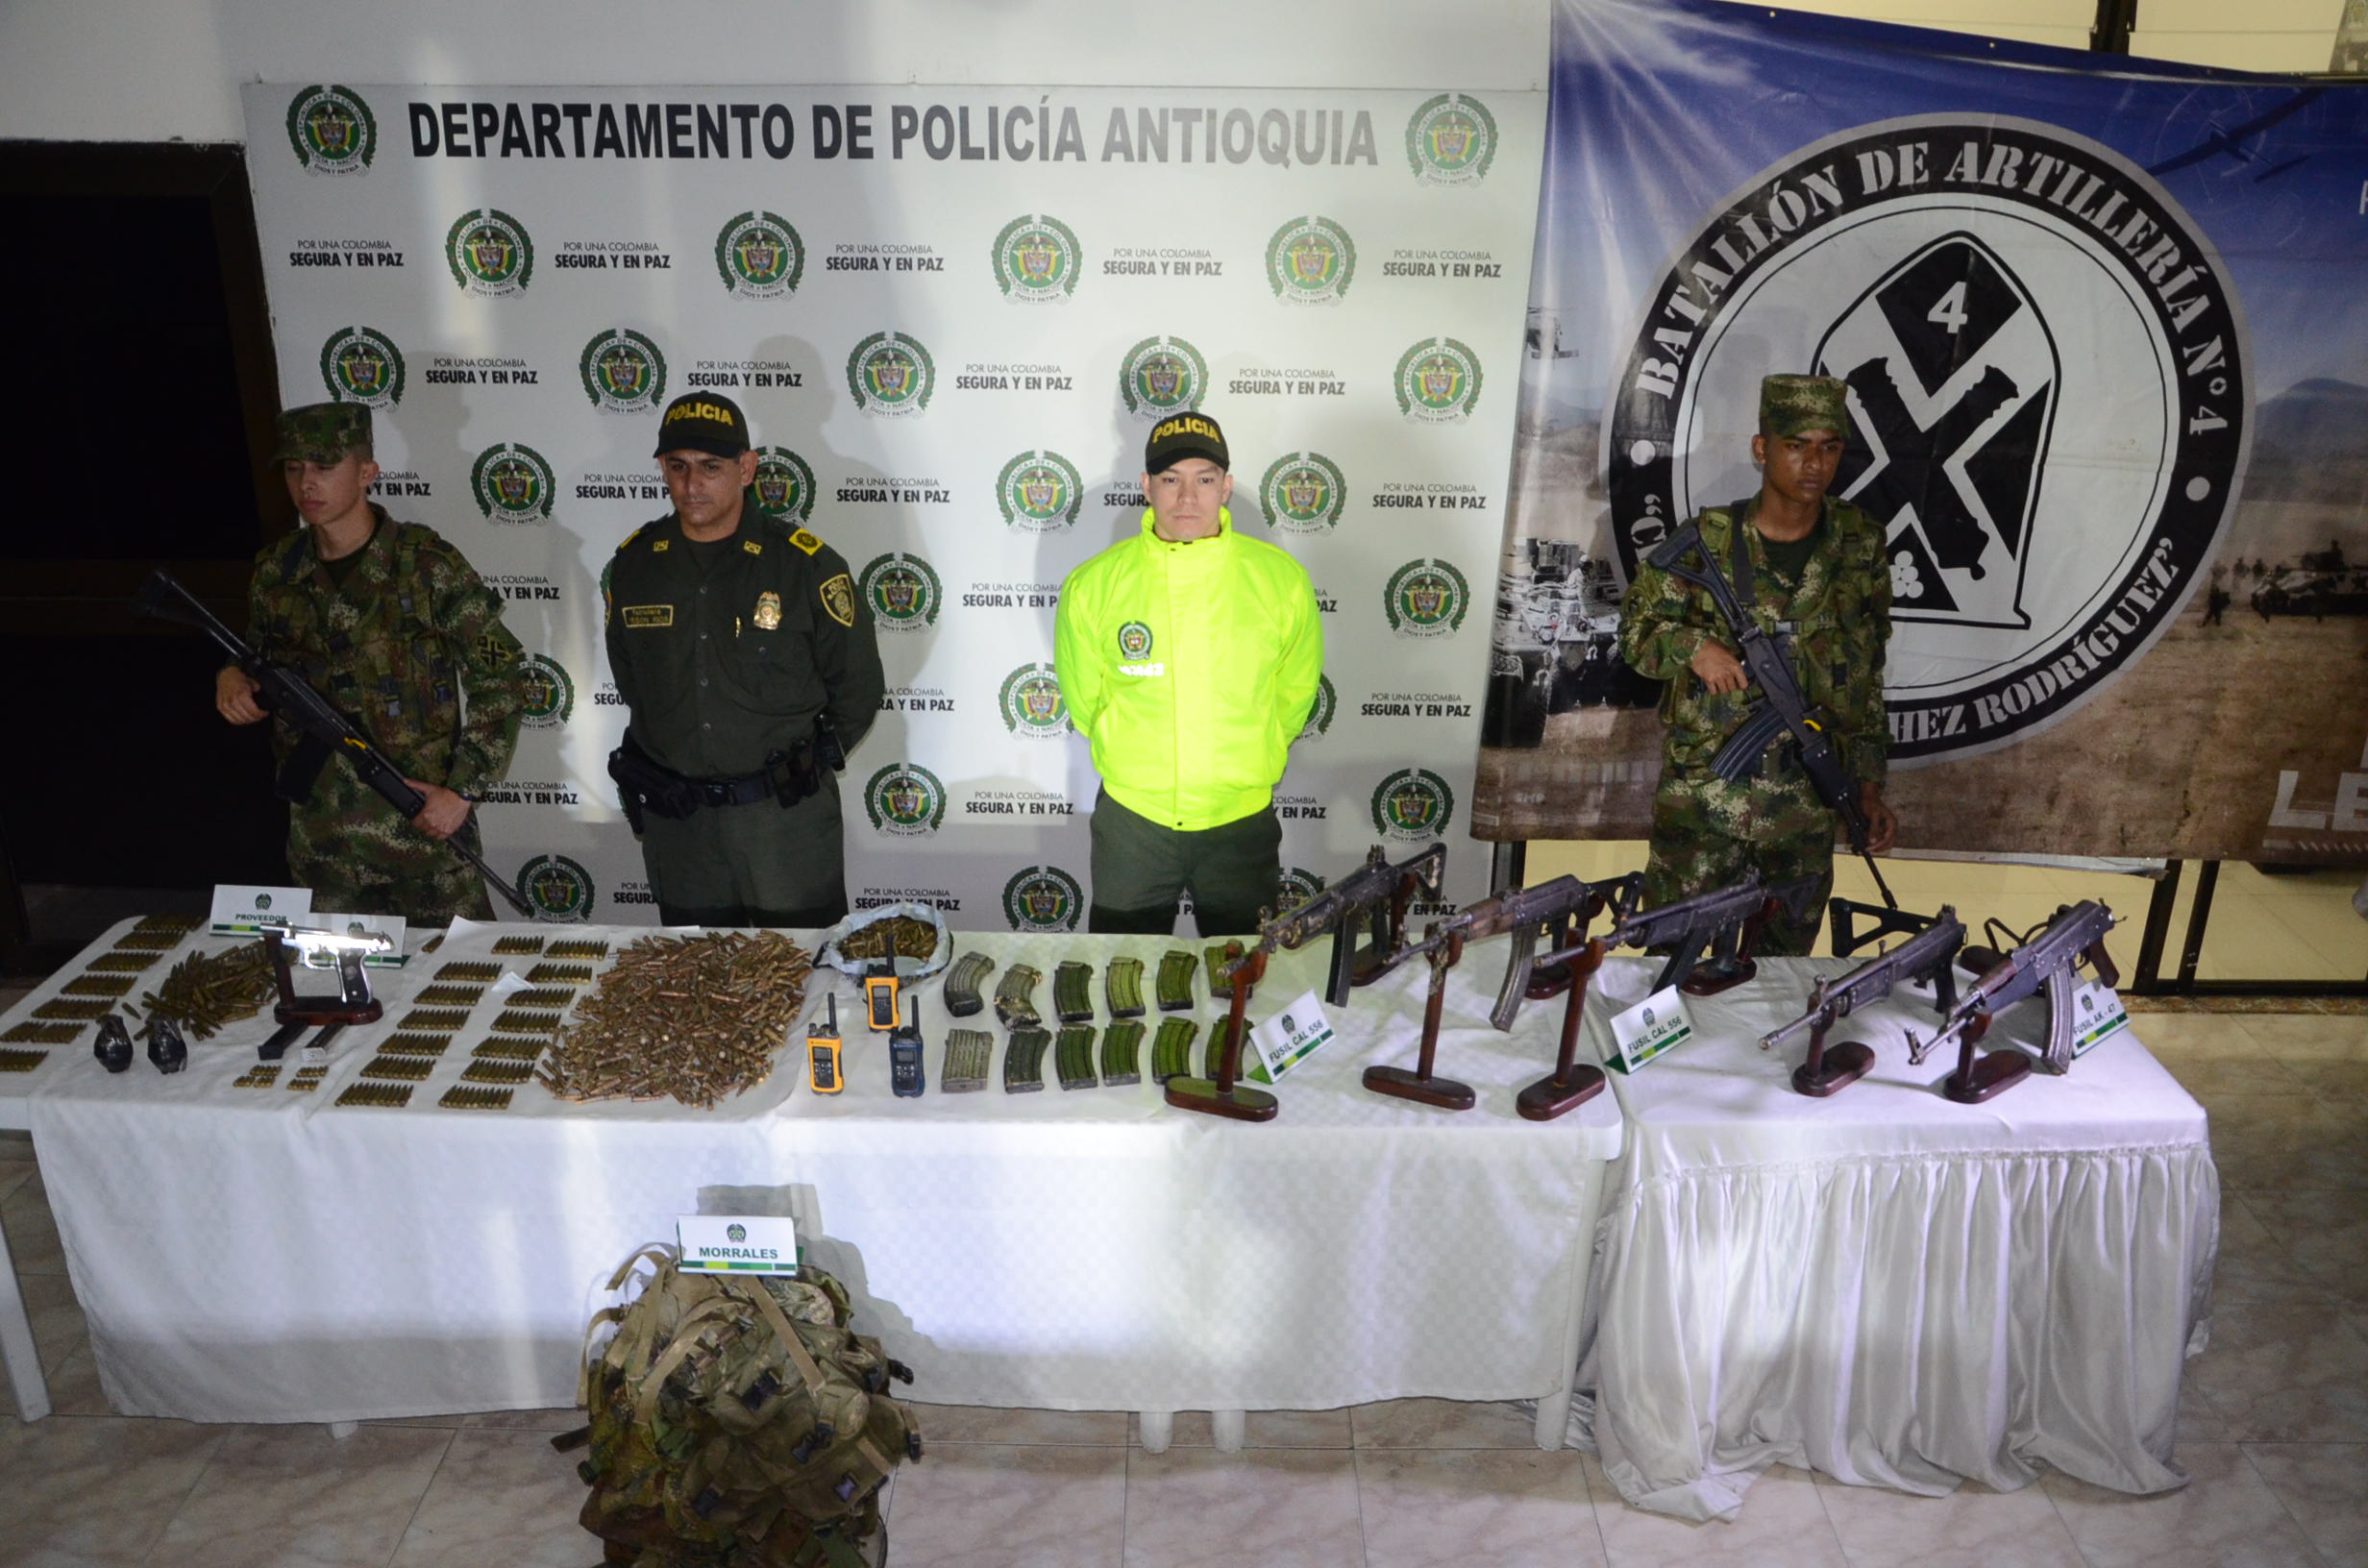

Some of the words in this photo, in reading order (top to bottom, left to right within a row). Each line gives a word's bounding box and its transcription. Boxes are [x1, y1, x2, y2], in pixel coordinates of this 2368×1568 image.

[408, 102, 795, 160] DEPARTAMENTO
[812, 104, 875, 160] DE
[891, 94, 1087, 162] POLICÍA
[1100, 107, 1379, 170] ANTIOQUIA
[297, 239, 317, 250] POR
[317, 239, 341, 250] UNA
[341, 239, 392, 251] COLOMBIA
[563, 241, 583, 252] POR
[584, 241, 607, 252] UNA
[607, 241, 660, 253] COLOMBIA
[835, 243, 855, 255] POR
[856, 245, 879, 255] UNA
[881, 244, 933, 255] COLOMBIA
[289, 252, 341, 267] SEGURA
[343, 252, 353, 267] Y
[357, 252, 374, 266] EN
[377, 253, 404, 267] PAZ
[555, 254, 607, 268] SEGURA
[609, 255, 619, 268] Y
[623, 255, 640, 268] EN
[644, 255, 671, 268] PAZ
[1394, 249, 1414, 259] POR
[1415, 250, 1439, 260] UNA
[1439, 250, 1492, 261] COLOMBIA
[826, 257, 879, 271] SEGURA
[882, 257, 892, 271] Y
[896, 257, 913, 271] EN
[917, 257, 944, 271] PAZ
[1103, 260, 1156, 275] SEGURA
[1160, 261, 1170, 275] Y
[1173, 261, 1191, 276] EN
[1196, 261, 1222, 276] PAZ
[1383, 261, 1436, 277] SEGURA
[1440, 263, 1449, 277] Y
[1453, 263, 1470, 277] EN
[1474, 263, 1501, 278] PAZ
[1635, 164, 1843, 400] BATALLÓN
[1856, 142, 1930, 195] DE
[1943, 141, 2210, 333] ARTILLERÍA
[2188, 404, 2229, 435] 4
[1927, 281, 1968, 334] 4
[433, 357, 453, 368] POR
[454, 358, 477, 368] UNA
[477, 357, 527, 368] COLOMBIA
[696, 360, 716, 370] POR
[717, 360, 740, 370] UNA
[740, 360, 792, 371] COLOMBIA
[966, 363, 985, 374] POR
[987, 364, 1010, 374] UNA
[1010, 364, 1062, 374] COLOMBIA
[426, 370, 477, 384] SEGURA
[479, 370, 487, 383] Y
[492, 371, 508, 384] EN
[511, 371, 538, 384] PAZ
[688, 373, 739, 387] SEGURA
[742, 373, 752, 386] Y
[755, 373, 772, 386] EN
[776, 373, 802, 386] PAZ
[956, 376, 1008, 390] SEGURA
[1012, 377, 1021, 390] Y
[1025, 377, 1042, 390] EN
[1046, 377, 1073, 390] PAZ
[1229, 380, 1281, 394] SEGURA
[1285, 380, 1294, 394] Y
[1297, 381, 1315, 395] EN
[1319, 381, 1345, 396] PAZ
[665, 402, 734, 427] POLICIA
[1152, 416, 1221, 444] POLICIA
[379, 471, 420, 481] OLOMBIA
[583, 474, 603, 483] POR
[604, 474, 626, 484] UNA
[845, 477, 865, 487] POR
[866, 478, 889, 487] UNA
[889, 478, 940, 487] COLOMBIA
[374, 482, 382, 496] Y
[385, 482, 403, 496] EN
[406, 482, 432, 497] PAZ
[576, 485, 627, 499] SEGURA
[629, 485, 638, 499] Y
[641, 486, 658, 500] EN
[1113, 481, 1131, 491] POR
[1383, 482, 1402, 492] POR
[1403, 483, 1425, 493] UNA
[1427, 483, 1477, 493] COLOMBIA
[836, 489, 888, 502] SEGURA
[891, 489, 900, 502] Y
[903, 490, 920, 502] EN
[925, 490, 950, 502] PAZ
[1372, 495, 1423, 507] SEGURA
[1428, 496, 1436, 508] Y
[1440, 496, 1456, 508] EN
[1461, 496, 1486, 509] PAZ
[501, 576, 550, 584] COLOMBIA
[503, 586, 512, 600] Y
[515, 586, 531, 600] EN
[534, 587, 560, 600] PAZ
[972, 582, 990, 592] POR
[992, 582, 1013, 592] UNA
[962, 594, 1013, 607] SEGURA
[1017, 595, 1025, 607] Y
[1029, 596, 1045, 608] EN
[896, 687, 945, 697] COLOMBIA
[1371, 693, 1390, 701] POR
[1391, 693, 1413, 701] UNA
[1414, 693, 1462, 702] COLOMBIA
[898, 698, 906, 711] Y
[910, 698, 925, 711] EN
[929, 699, 955, 712] PAZ
[1361, 703, 1410, 716] SEGURA
[1415, 704, 1422, 717] Y
[1426, 704, 1442, 717] EN
[1446, 705, 1471, 717] PAZ
[500, 780, 520, 790] UNA
[522, 781, 568, 791] COLOMBIA
[524, 792, 532, 804] Y
[535, 793, 552, 805] EN
[555, 793, 579, 805] PAZ
[974, 791, 993, 799] POR
[1016, 792, 1064, 800] COLOMBIA
[966, 801, 1014, 814] SEGURA
[1018, 802, 1025, 814] Y
[1030, 803, 1045, 815] EN
[1049, 803, 1073, 815] PAZ
[1282, 807, 1298, 820] EN
[1301, 807, 1327, 820] PAZ
[621, 882, 639, 891] POR
[863, 888, 881, 896] POR
[882, 888, 902, 897] UNA
[904, 889, 950, 898] COLOMBIA
[936, 898, 961, 911] PAZ
[1413, 904, 1429, 916] EN
[1432, 904, 1457, 916] PAZ
[234, 913, 288, 922] PROVEEDOR
[1269, 1041, 1294, 1063] FUSIL
[1292, 1030, 1310, 1046] CAL
[1308, 1018, 1323, 1035] 556
[1627, 1035, 1651, 1054] FUSIL
[1651, 1025, 1668, 1039] CAL
[1667, 1016, 1683, 1030] 556
[699, 1246, 778, 1260] MORRALES
